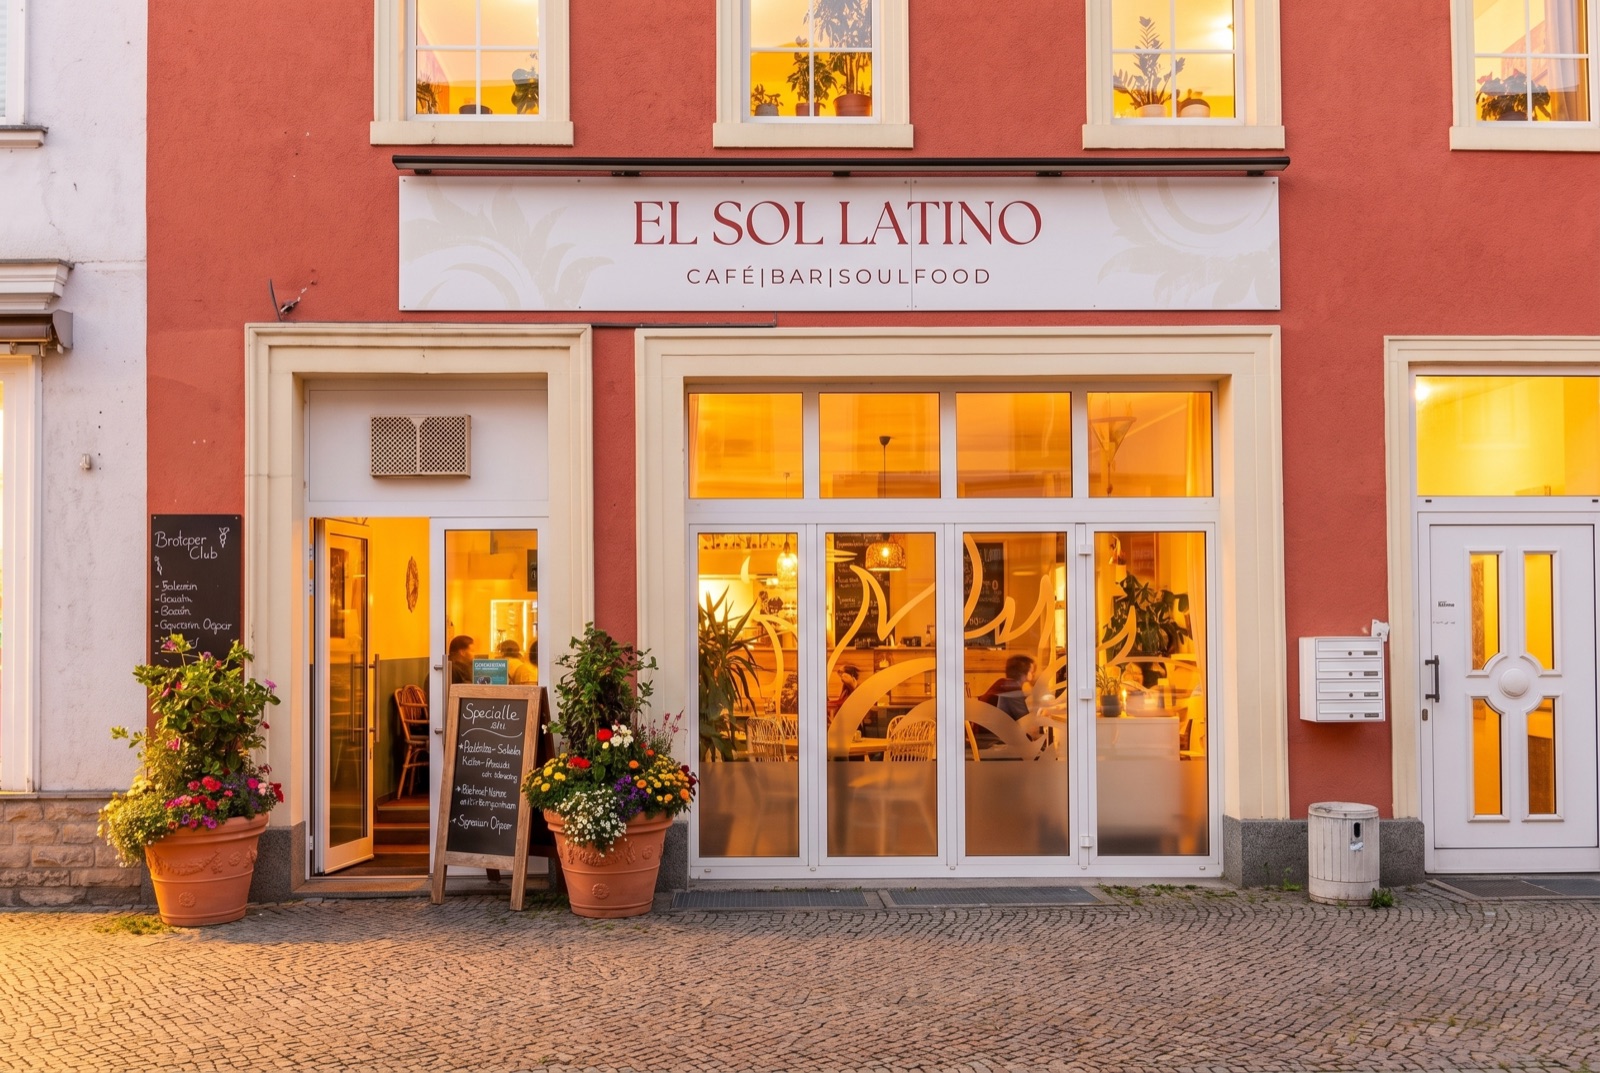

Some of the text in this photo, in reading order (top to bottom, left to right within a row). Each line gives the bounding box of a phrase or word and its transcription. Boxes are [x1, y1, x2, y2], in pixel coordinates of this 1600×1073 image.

[634, 200, 1042, 246] EL SOL LATINO
[687, 265, 990, 285] CAFÉ BAR SOULFOOD
[189, 545, 218, 560] Club
[463, 703, 520, 725] Specialle
